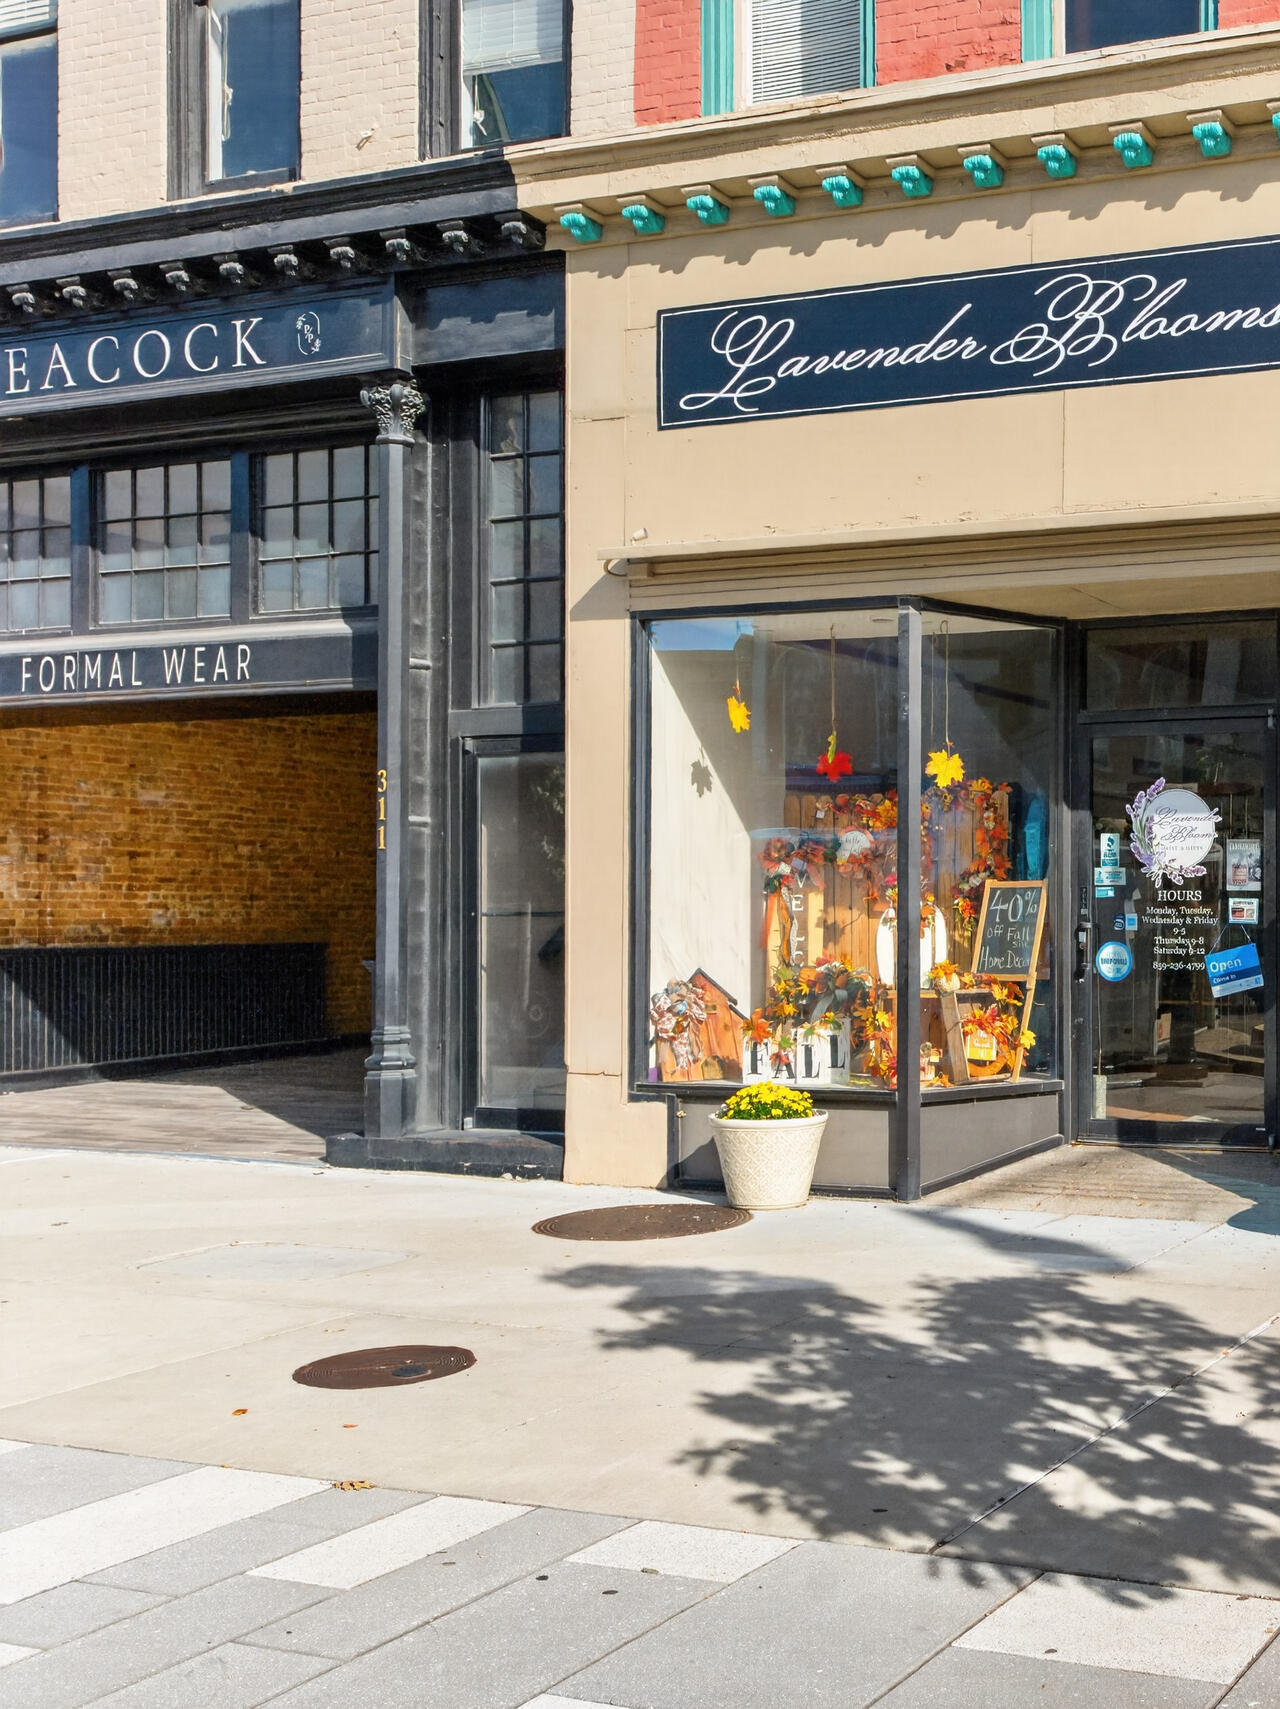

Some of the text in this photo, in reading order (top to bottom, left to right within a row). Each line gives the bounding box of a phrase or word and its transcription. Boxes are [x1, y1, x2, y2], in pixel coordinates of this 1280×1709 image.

[4, 317, 267, 394] EACOCK
[680, 302, 989, 412] Lavender
[21, 644, 251, 693] FORMAL WEAR
[1157, 889, 1202, 901] HOURS
[989, 889, 1038, 922] 40%
[1146, 906, 1214, 916] Monday, Tuesday,
[1142, 916, 1218, 926] Wednesday & Friday
[986, 924, 1030, 941] off Fall
[1153, 936, 1204, 946] Thursday 9-8
[1153, 946, 1187, 956] Saturday
[1209, 958, 1242, 974] Open
[747, 1034, 846, 1079] FALL
